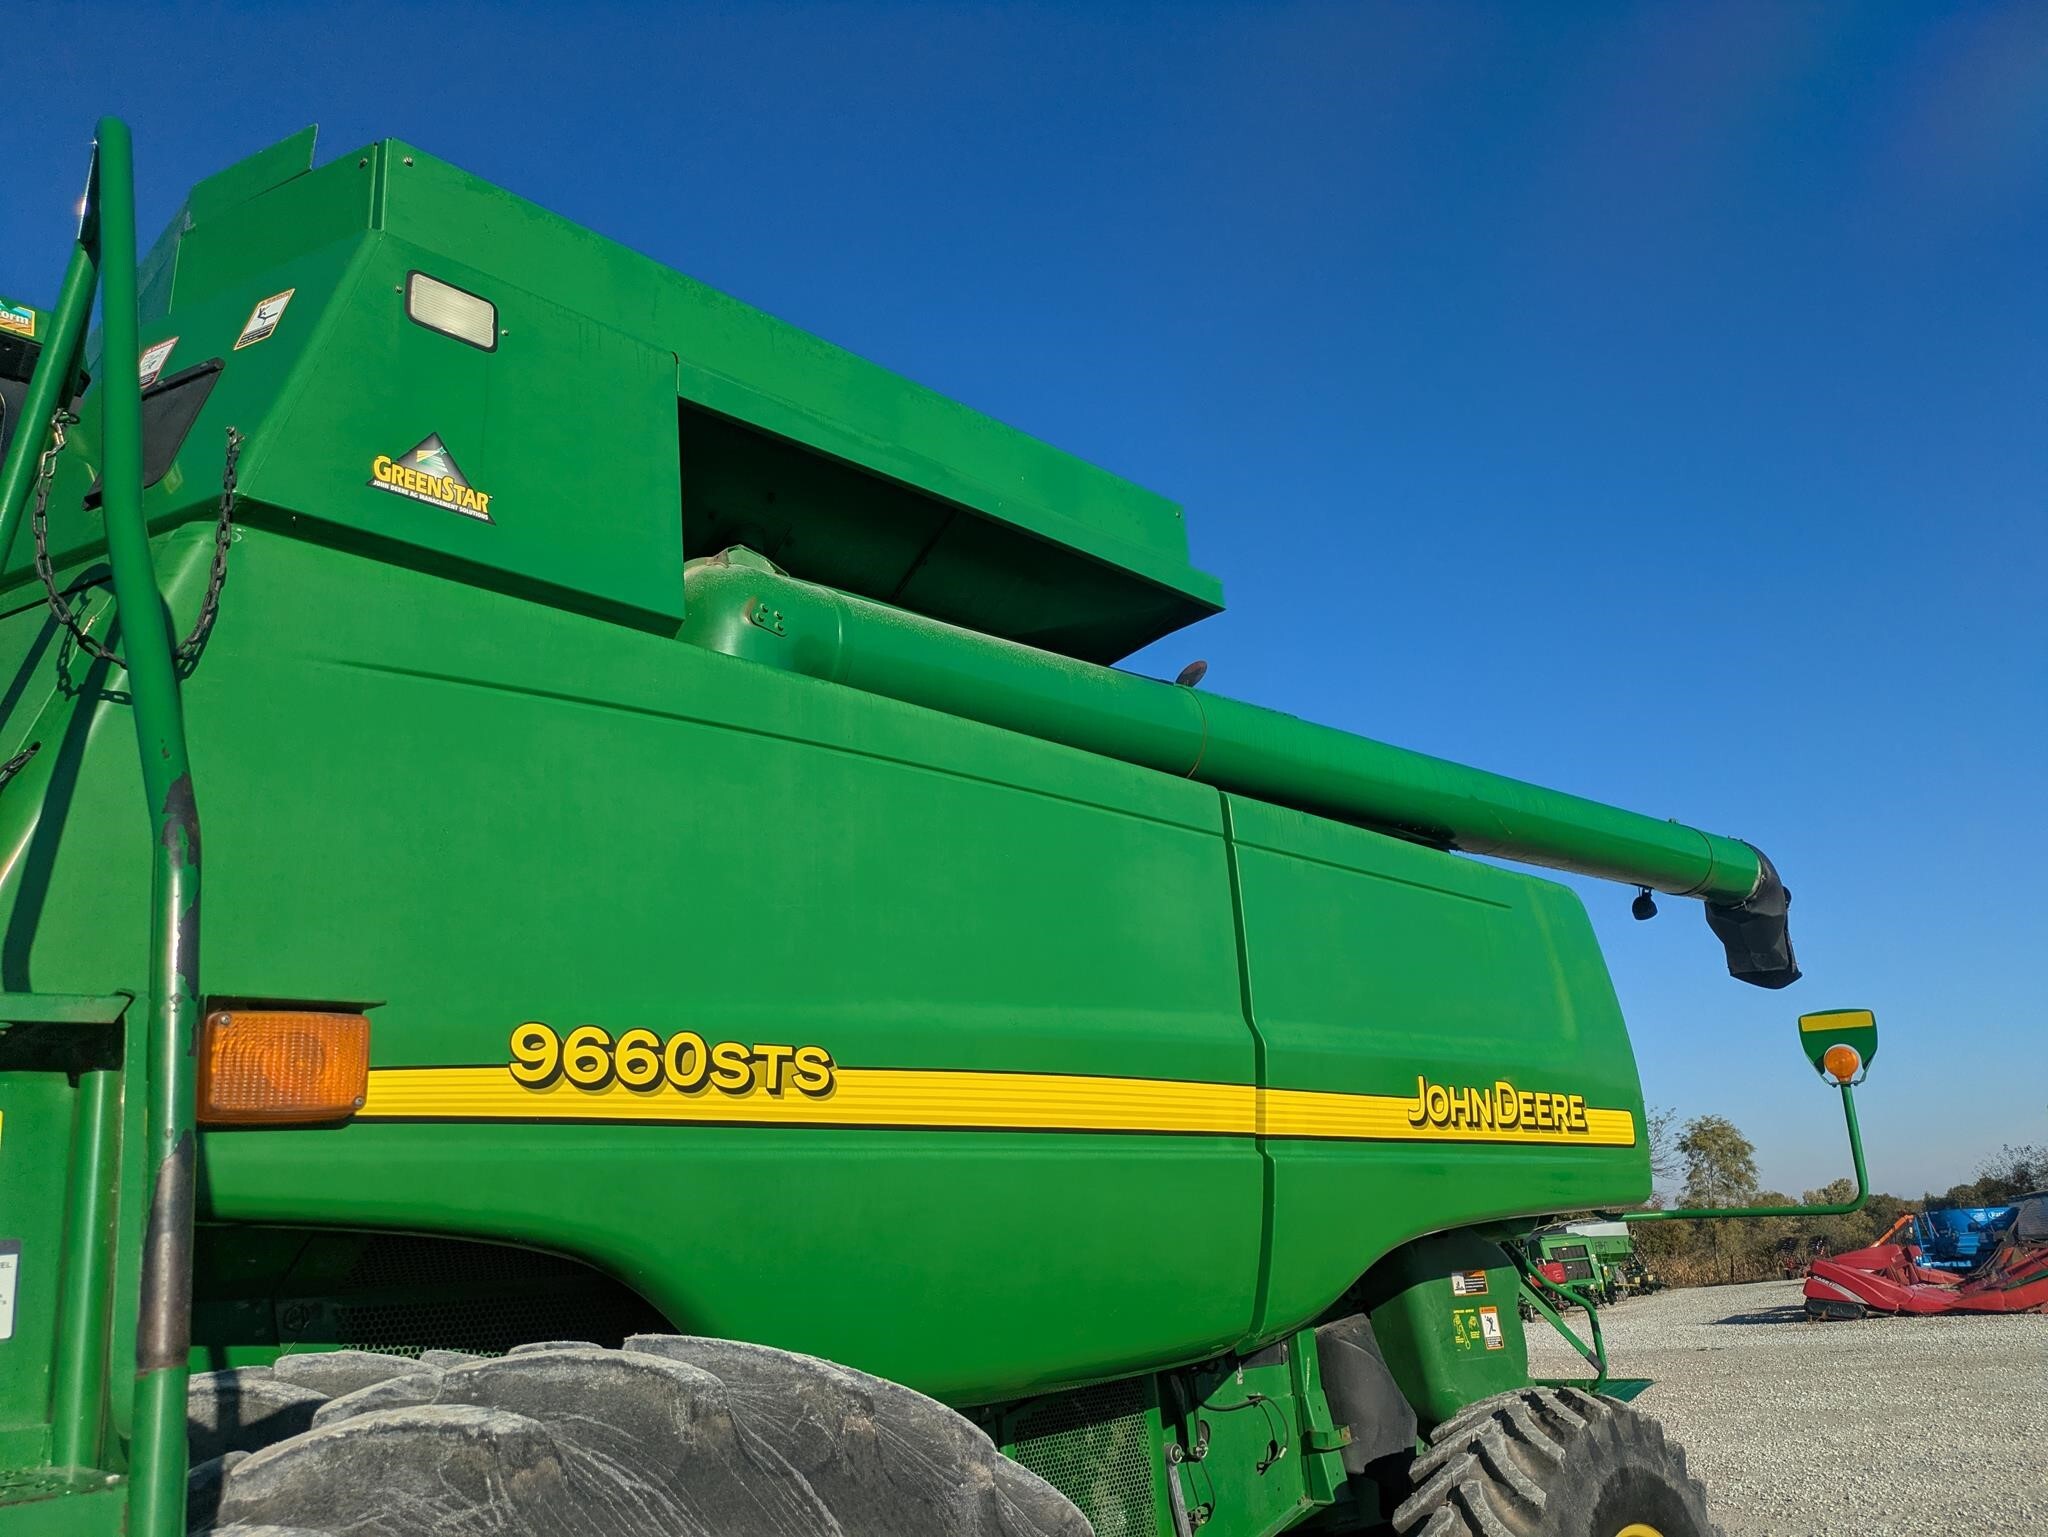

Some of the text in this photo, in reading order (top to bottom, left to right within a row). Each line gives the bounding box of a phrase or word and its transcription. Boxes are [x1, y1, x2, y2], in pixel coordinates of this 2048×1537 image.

[0, 310, 28, 325] orm
[373, 479, 389, 491] JOHN
[419, 491, 459, 511] MANAGEMENT
[459, 505, 489, 521] SOLUTIONS
[508, 1021, 835, 1096] 9660STS
